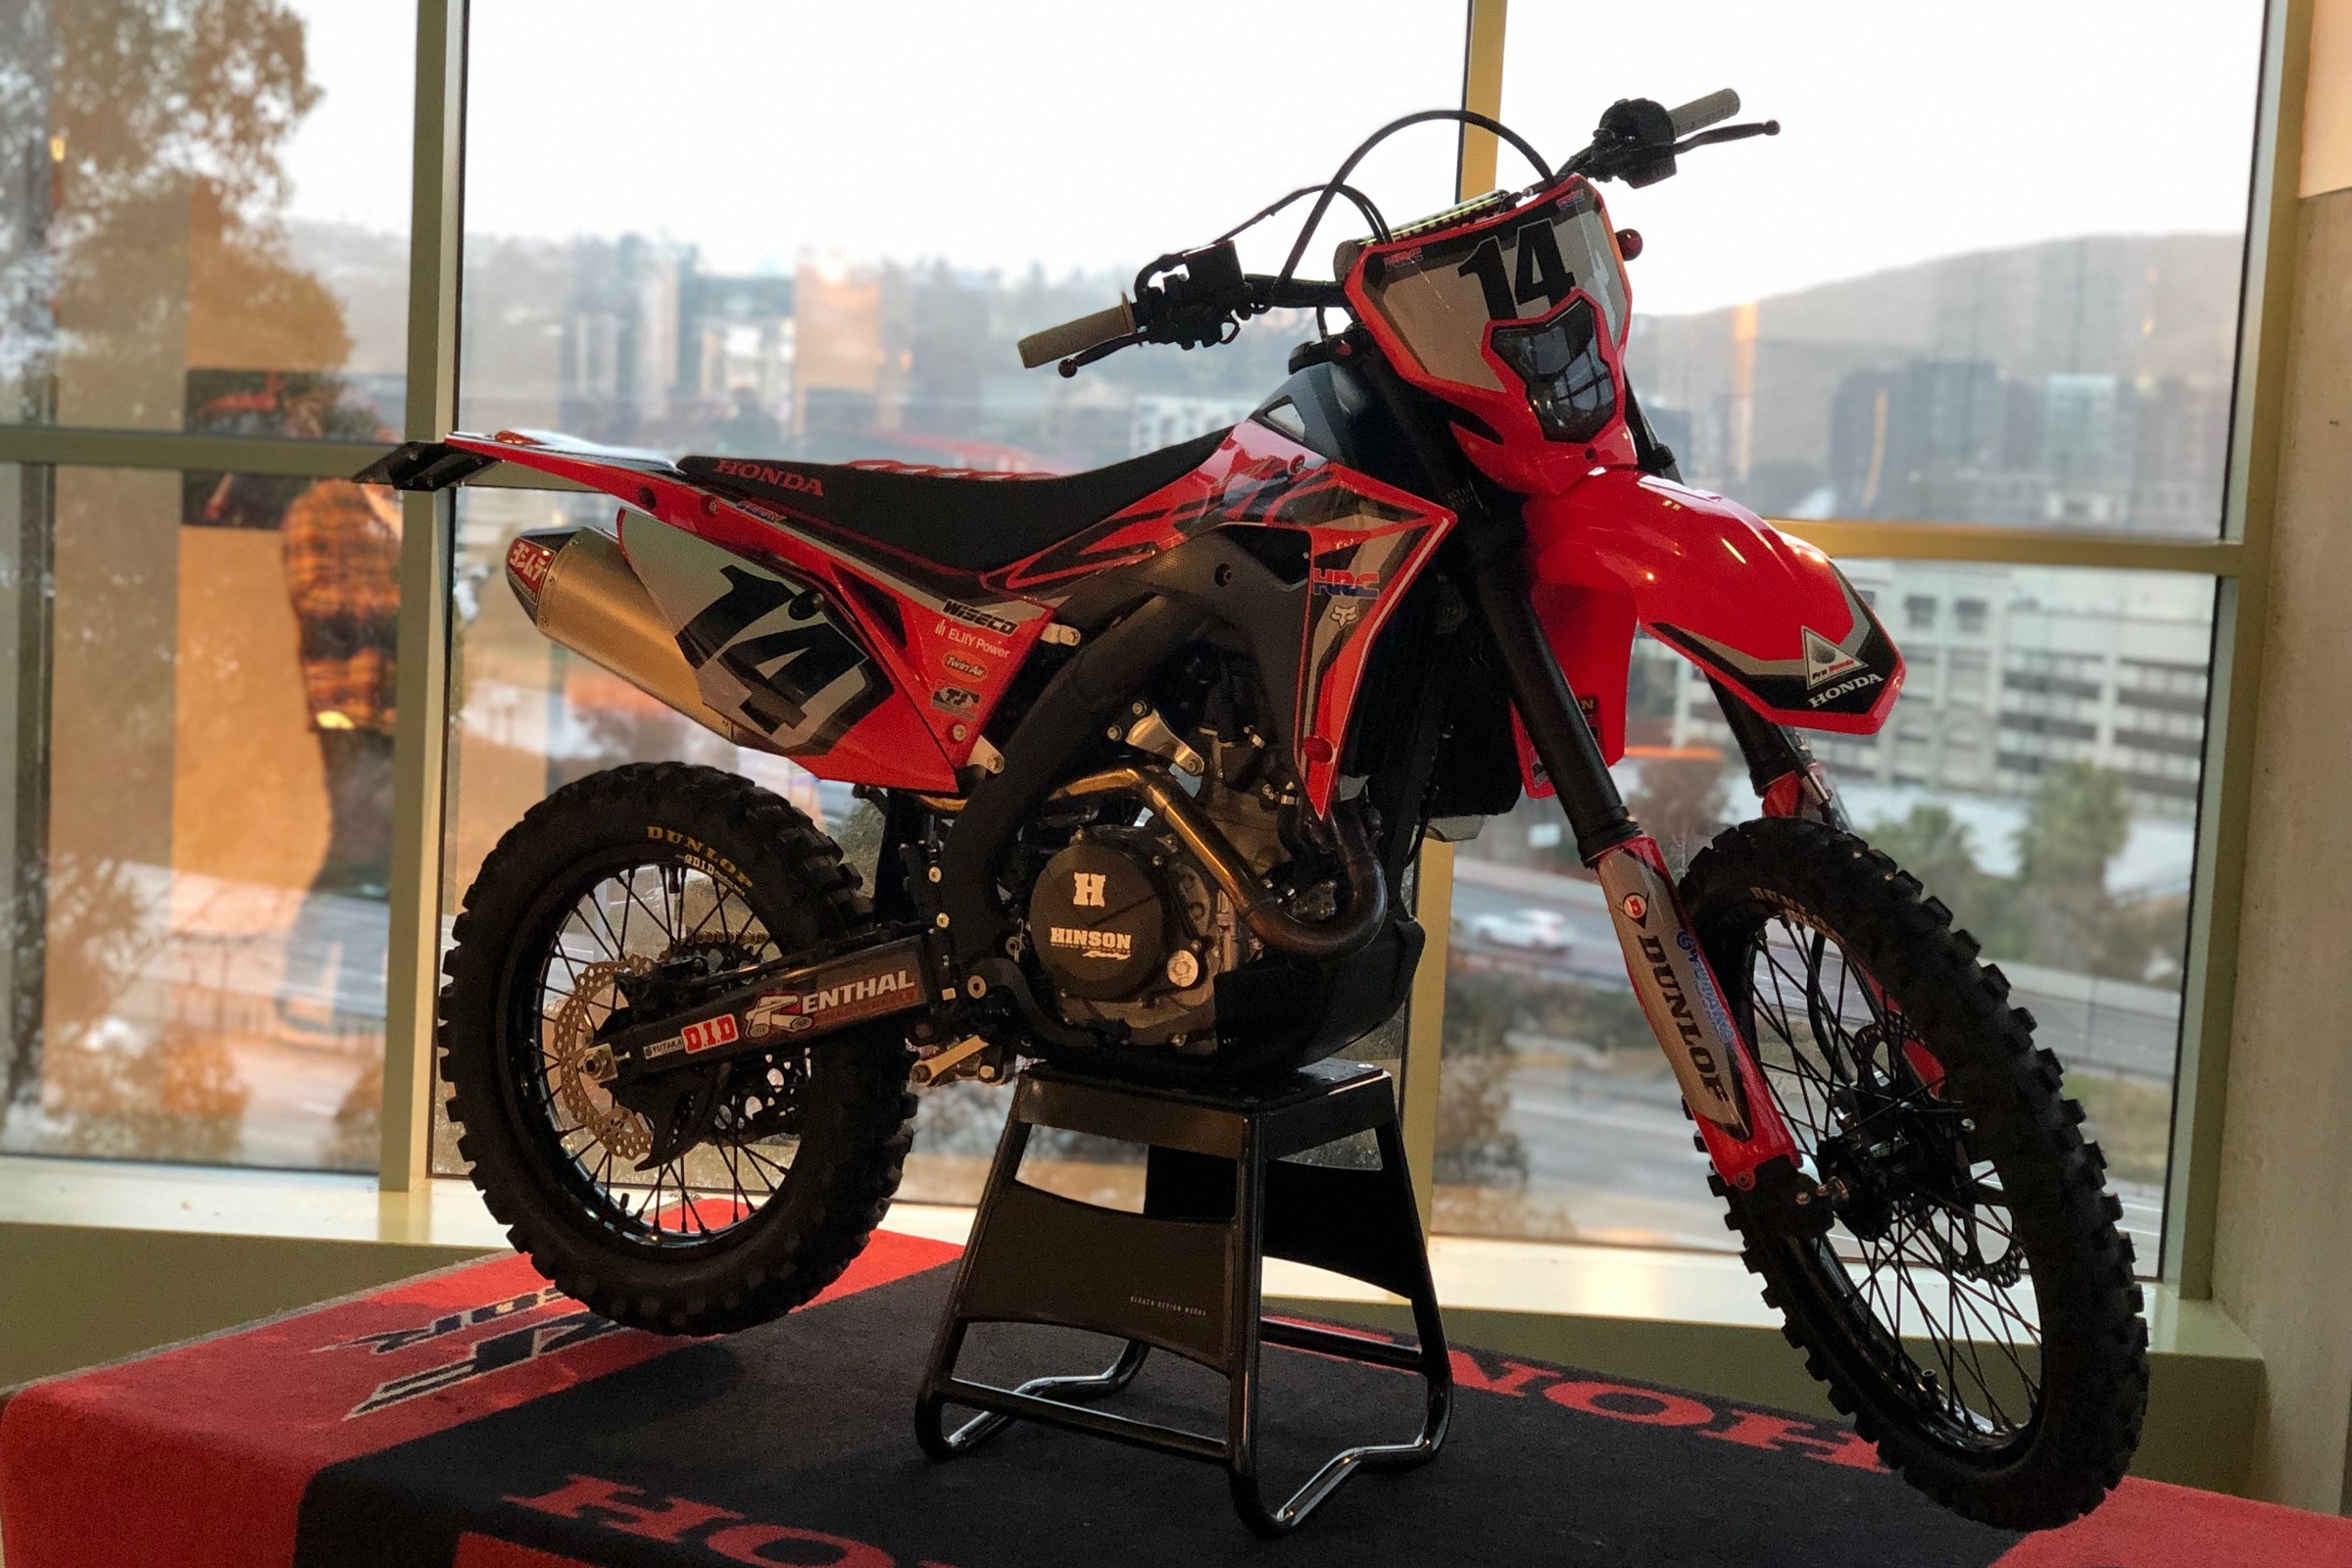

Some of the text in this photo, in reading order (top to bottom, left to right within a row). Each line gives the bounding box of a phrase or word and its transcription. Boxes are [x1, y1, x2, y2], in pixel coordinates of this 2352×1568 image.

[1458, 218, 1577, 319] 14
[714, 458, 823, 497] HONDA
[1312, 567, 1380, 600] HRC
[674, 564, 869, 735] 14
[947, 656, 986, 677] Twin Air
[976, 638, 1010, 659] Power
[1808, 673, 1885, 708] HONDA
[647, 825, 754, 888] DUNLOP
[1072, 872, 1106, 907] H
[1051, 927, 1132, 950] HINSON
[1637, 934, 1730, 1103] DUNLOP
[502, 1473, 960, 1568] HO
